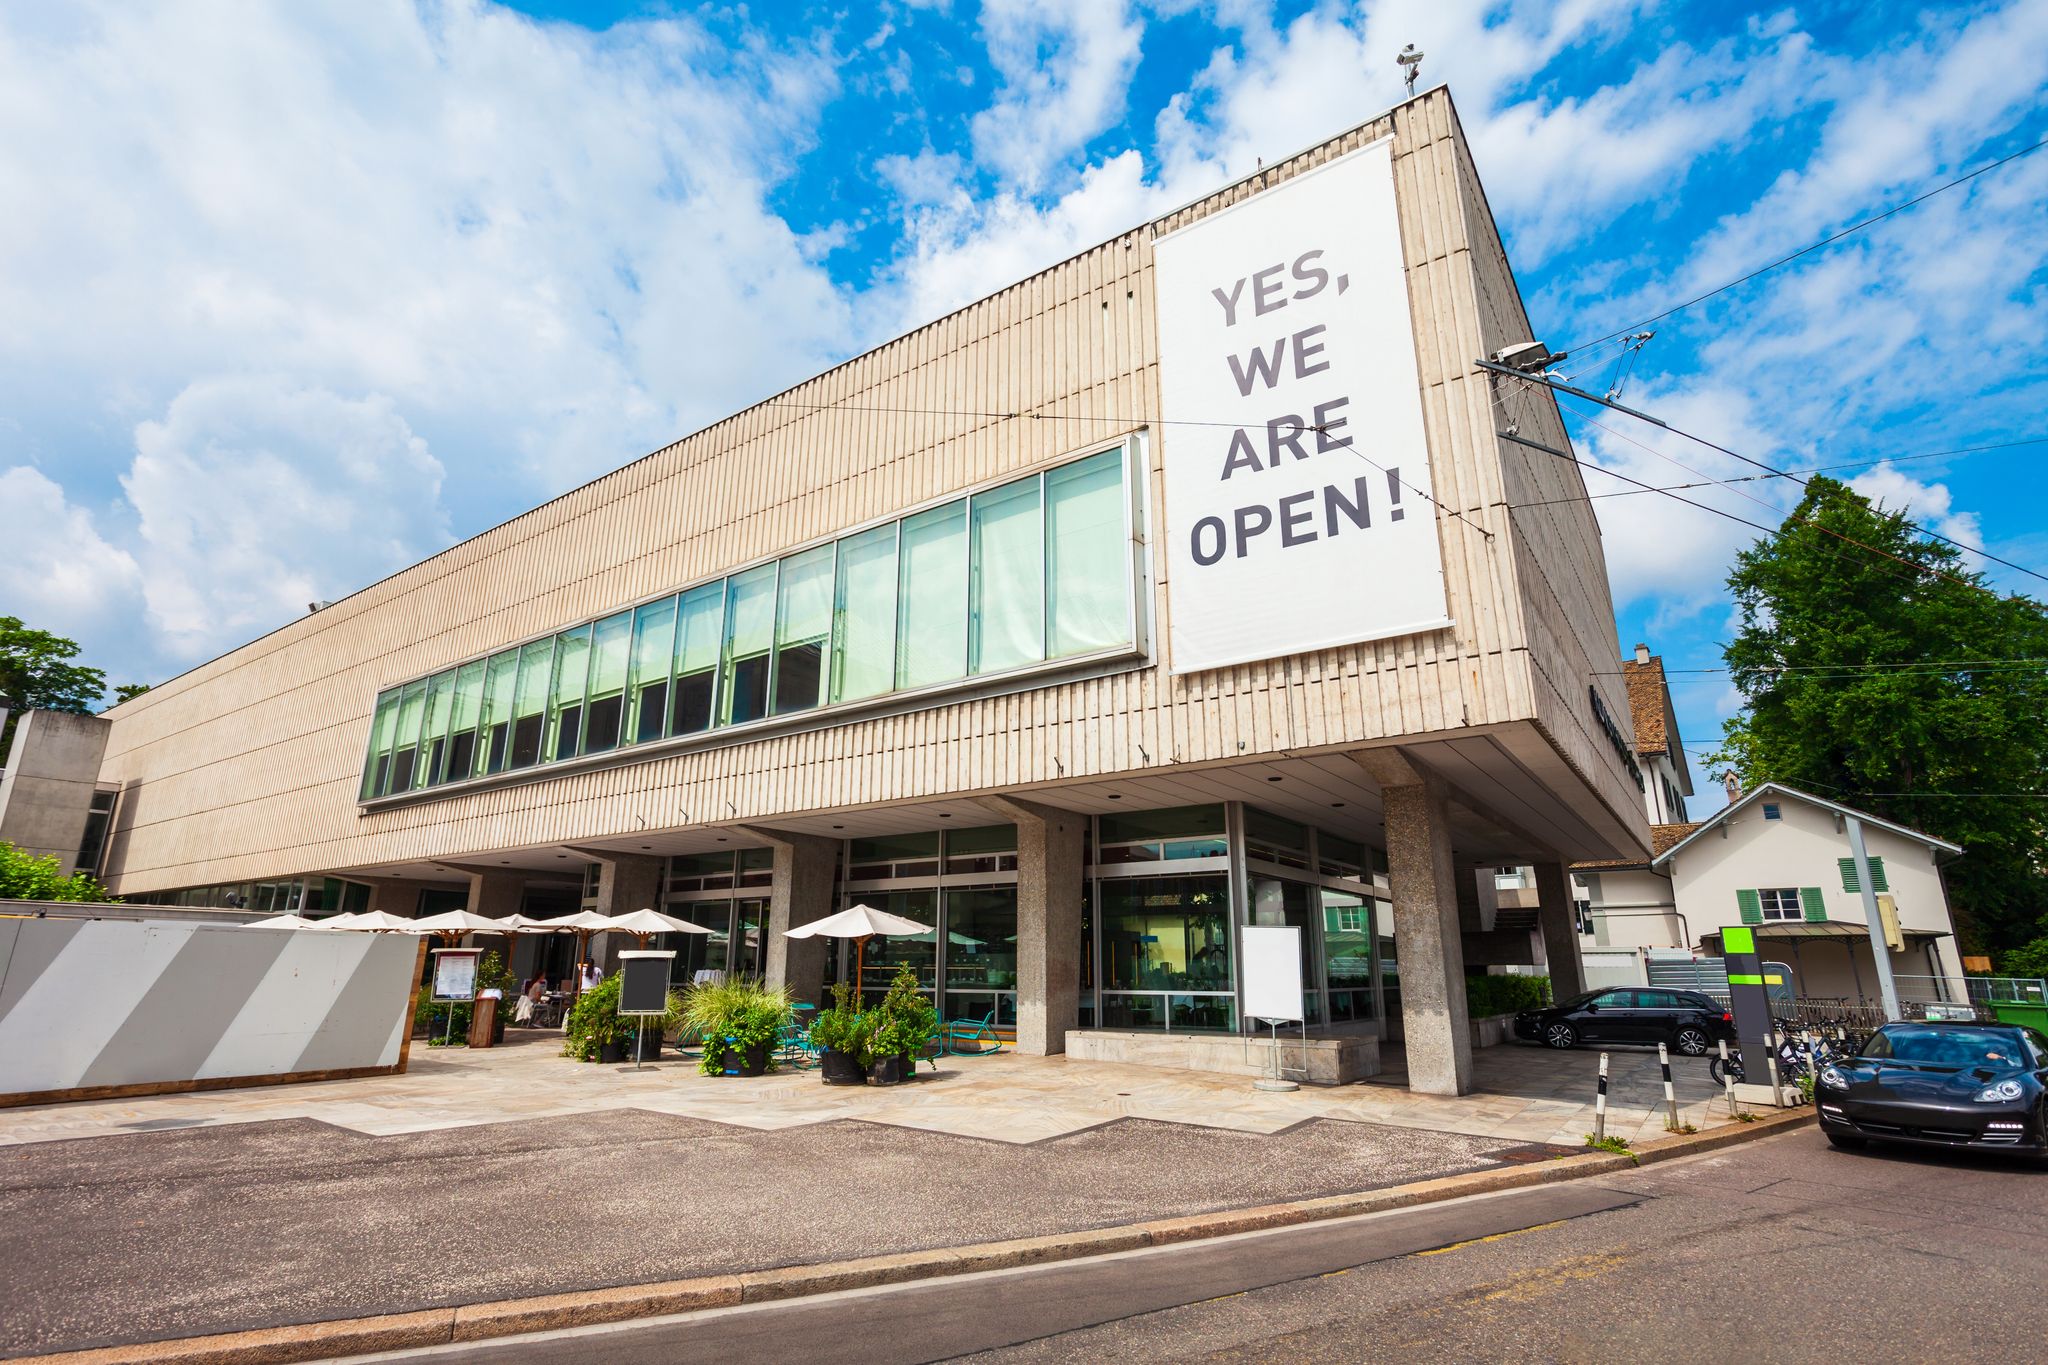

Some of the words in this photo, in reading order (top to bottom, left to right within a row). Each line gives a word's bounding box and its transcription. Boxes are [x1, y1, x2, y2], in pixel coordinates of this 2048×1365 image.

[1211, 250, 1349, 327] YES,
[1227, 324, 1330, 397] WE
[1221, 396, 1353, 481] ARE
[1191, 467, 1404, 566] OPEN!
